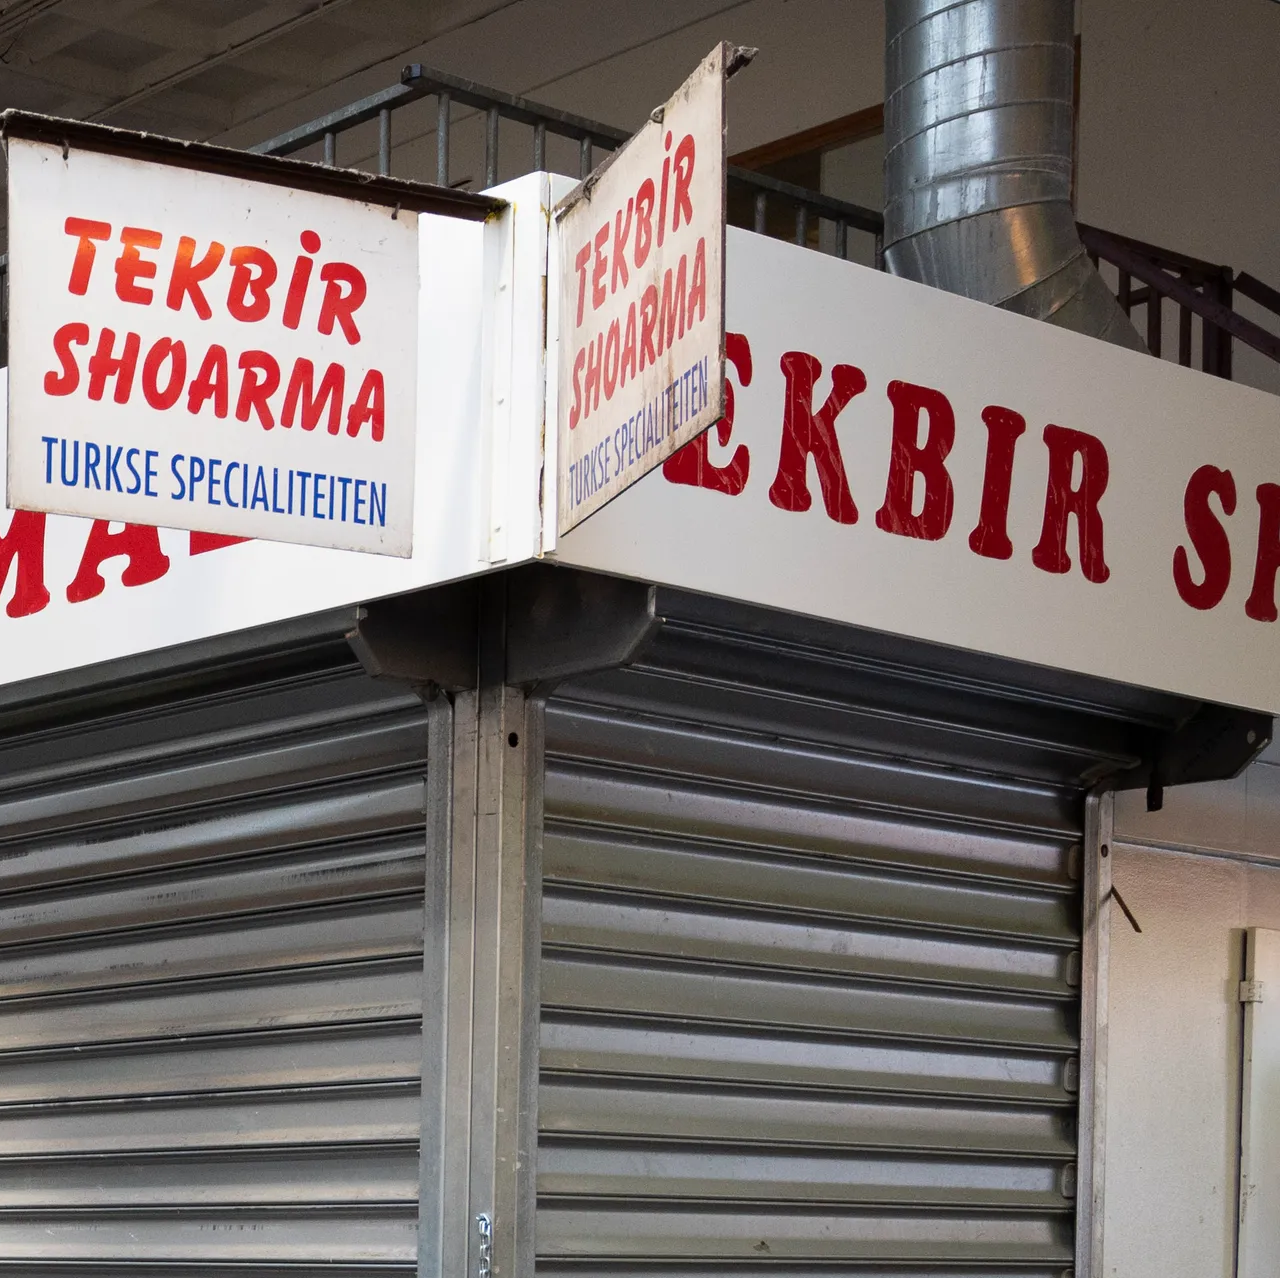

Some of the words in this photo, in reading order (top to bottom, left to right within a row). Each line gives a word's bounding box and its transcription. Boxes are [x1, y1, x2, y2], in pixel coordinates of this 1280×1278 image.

[43, 321, 386, 443] SHOARMA
[569, 236, 707, 431] SHOARMA
[42, 436, 159, 497] TURKSE
[170, 453, 387, 526] SPECIALITEITEN
[568, 434, 610, 511] TURKSE
[614, 355, 710, 475] SPECIALITEITEN
